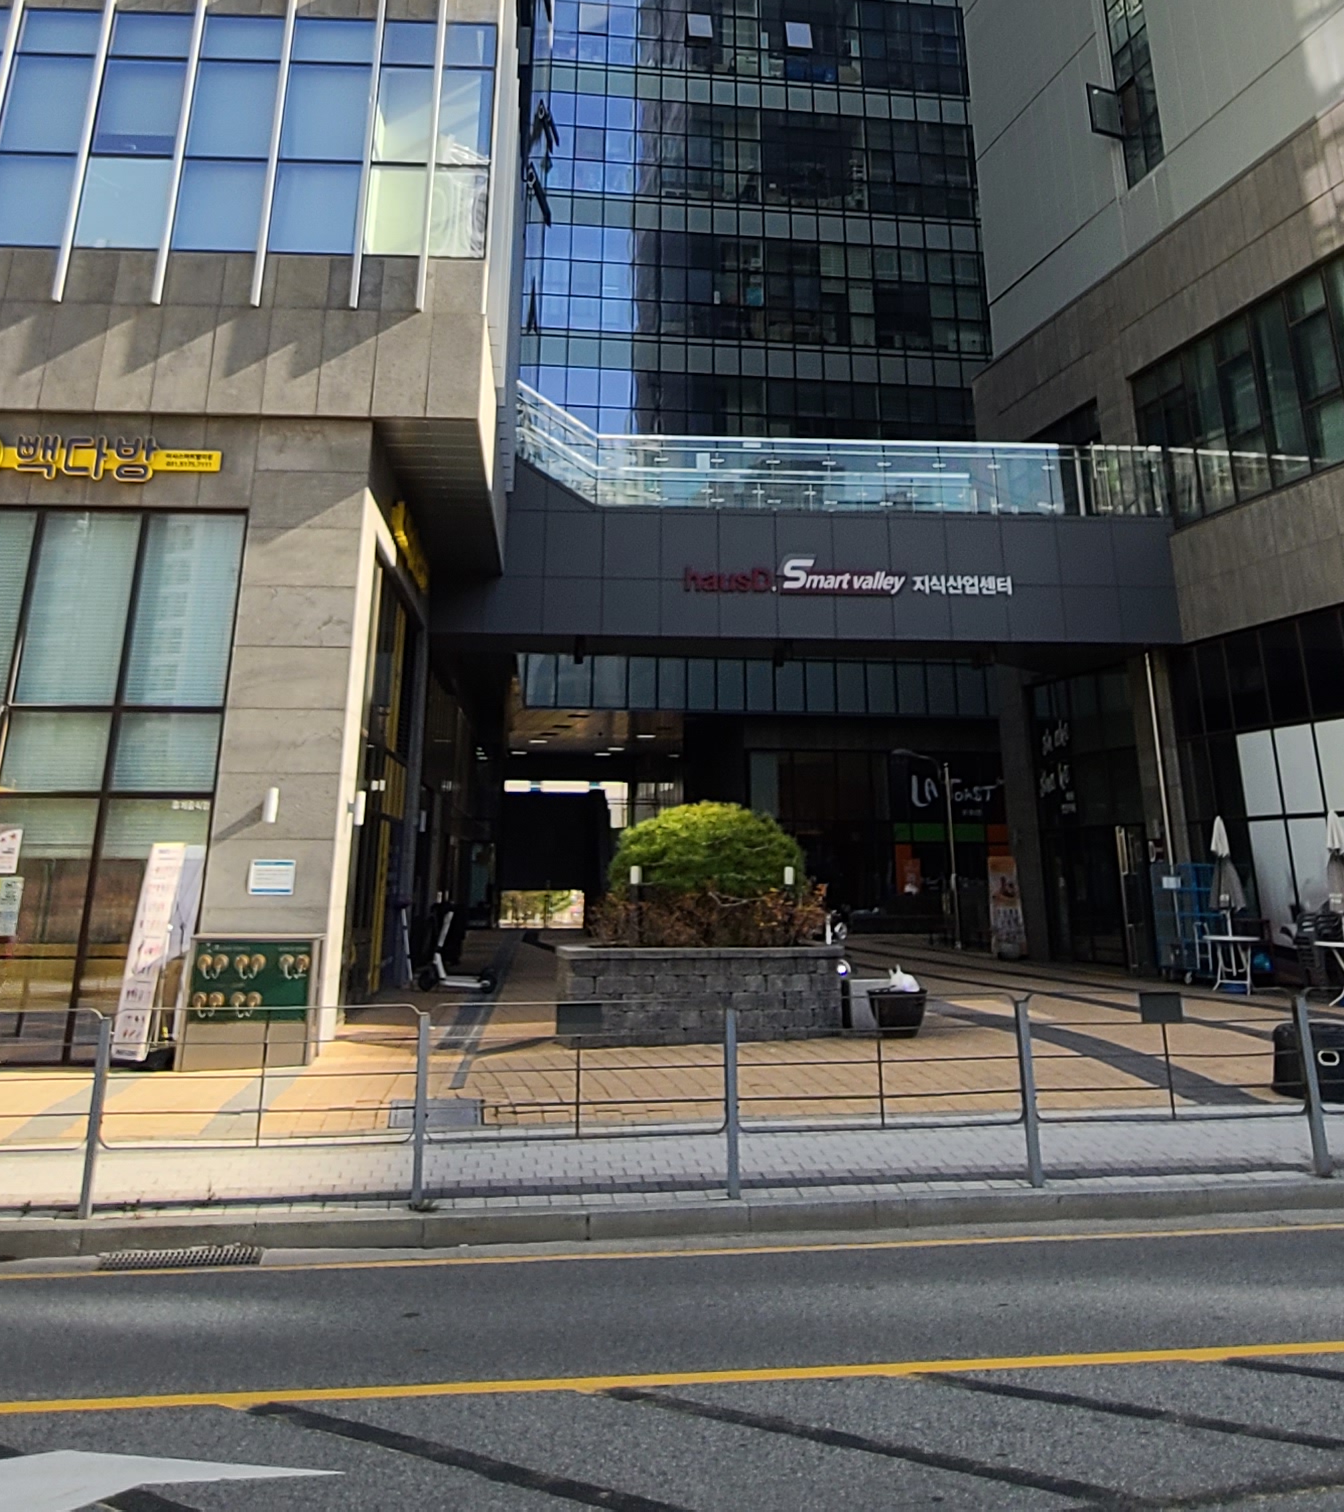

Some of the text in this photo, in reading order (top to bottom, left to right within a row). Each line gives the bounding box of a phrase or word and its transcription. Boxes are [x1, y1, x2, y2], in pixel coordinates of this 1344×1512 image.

[15, 434, 162, 482] 빽다방
[783, 558, 851, 590] Smart
[852, 571, 906, 594] valley
[912, 574, 1012, 595] 지식산업센터
